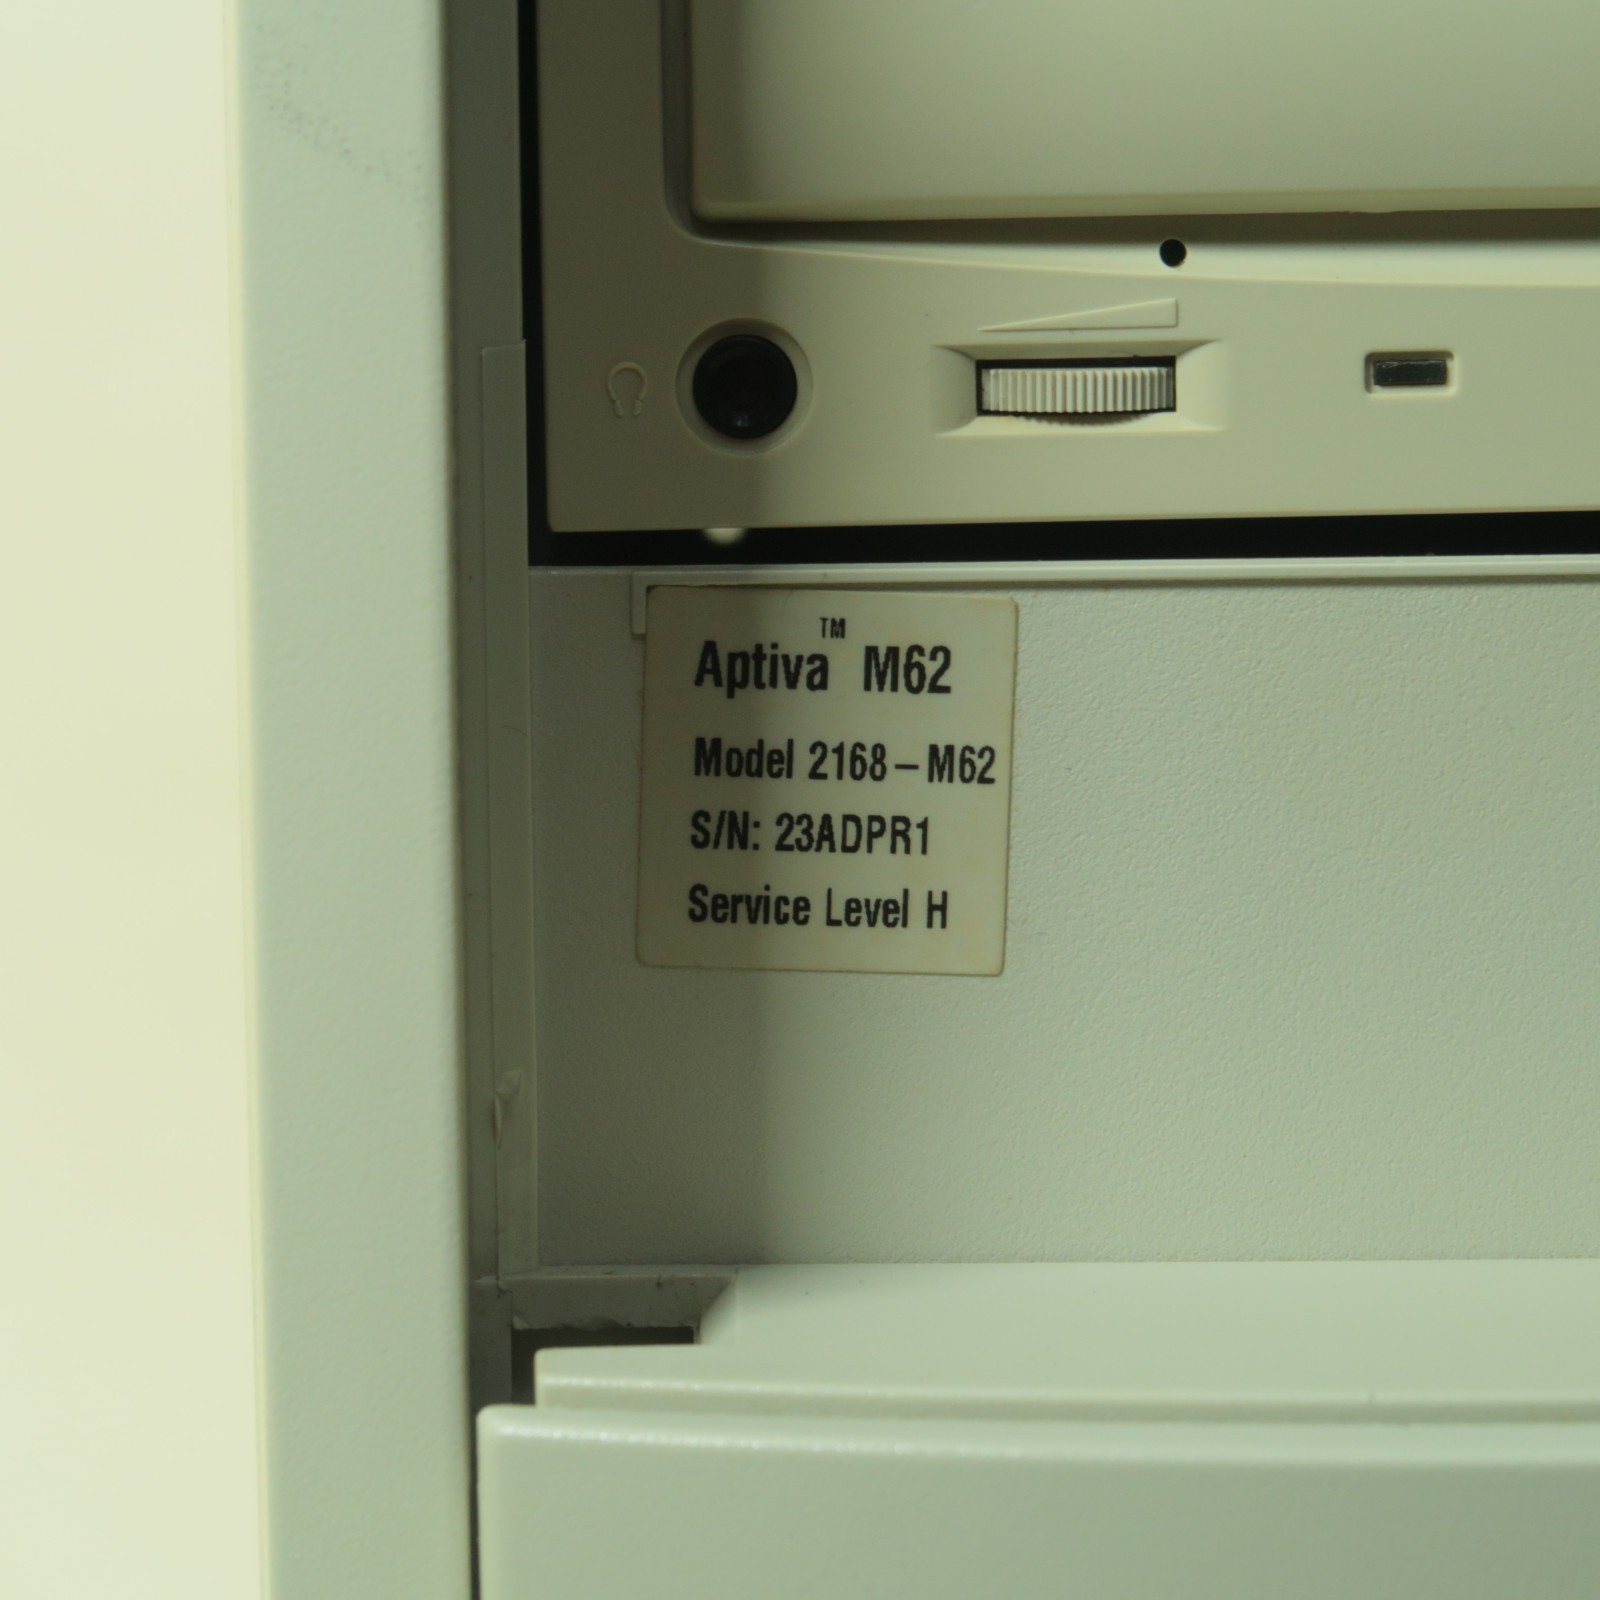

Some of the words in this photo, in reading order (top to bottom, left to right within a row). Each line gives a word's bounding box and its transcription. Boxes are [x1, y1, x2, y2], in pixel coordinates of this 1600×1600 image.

[693, 639, 830, 699] Aptiva
[863, 643, 952, 695] M62
[693, 736, 795, 780] Model
[690, 809, 761, 851] S/N:
[774, 811, 930, 856] 23ADPR1
[687, 882, 812, 927] Service
[825, 887, 910, 929] Level
[926, 890, 949, 930] H
